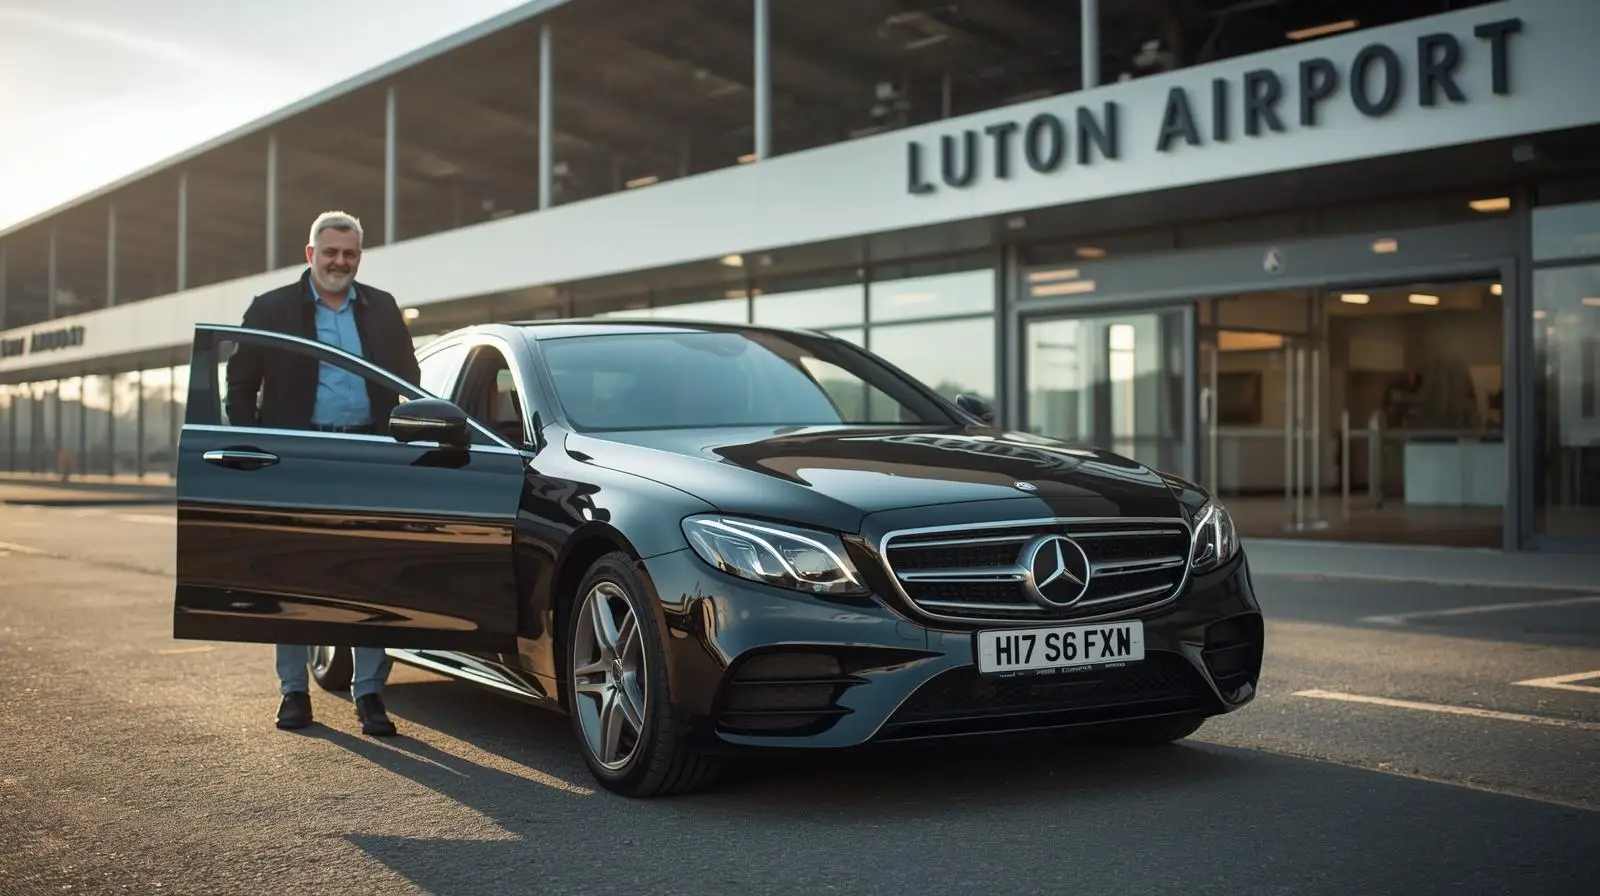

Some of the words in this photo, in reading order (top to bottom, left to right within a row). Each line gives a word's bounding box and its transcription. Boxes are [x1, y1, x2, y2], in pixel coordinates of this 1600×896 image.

[906, 101, 1121, 195] LUTON
[1156, 17, 1523, 153] AIRPORT
[1044, 631, 1078, 662] S6
[1083, 626, 1132, 659] FXN
